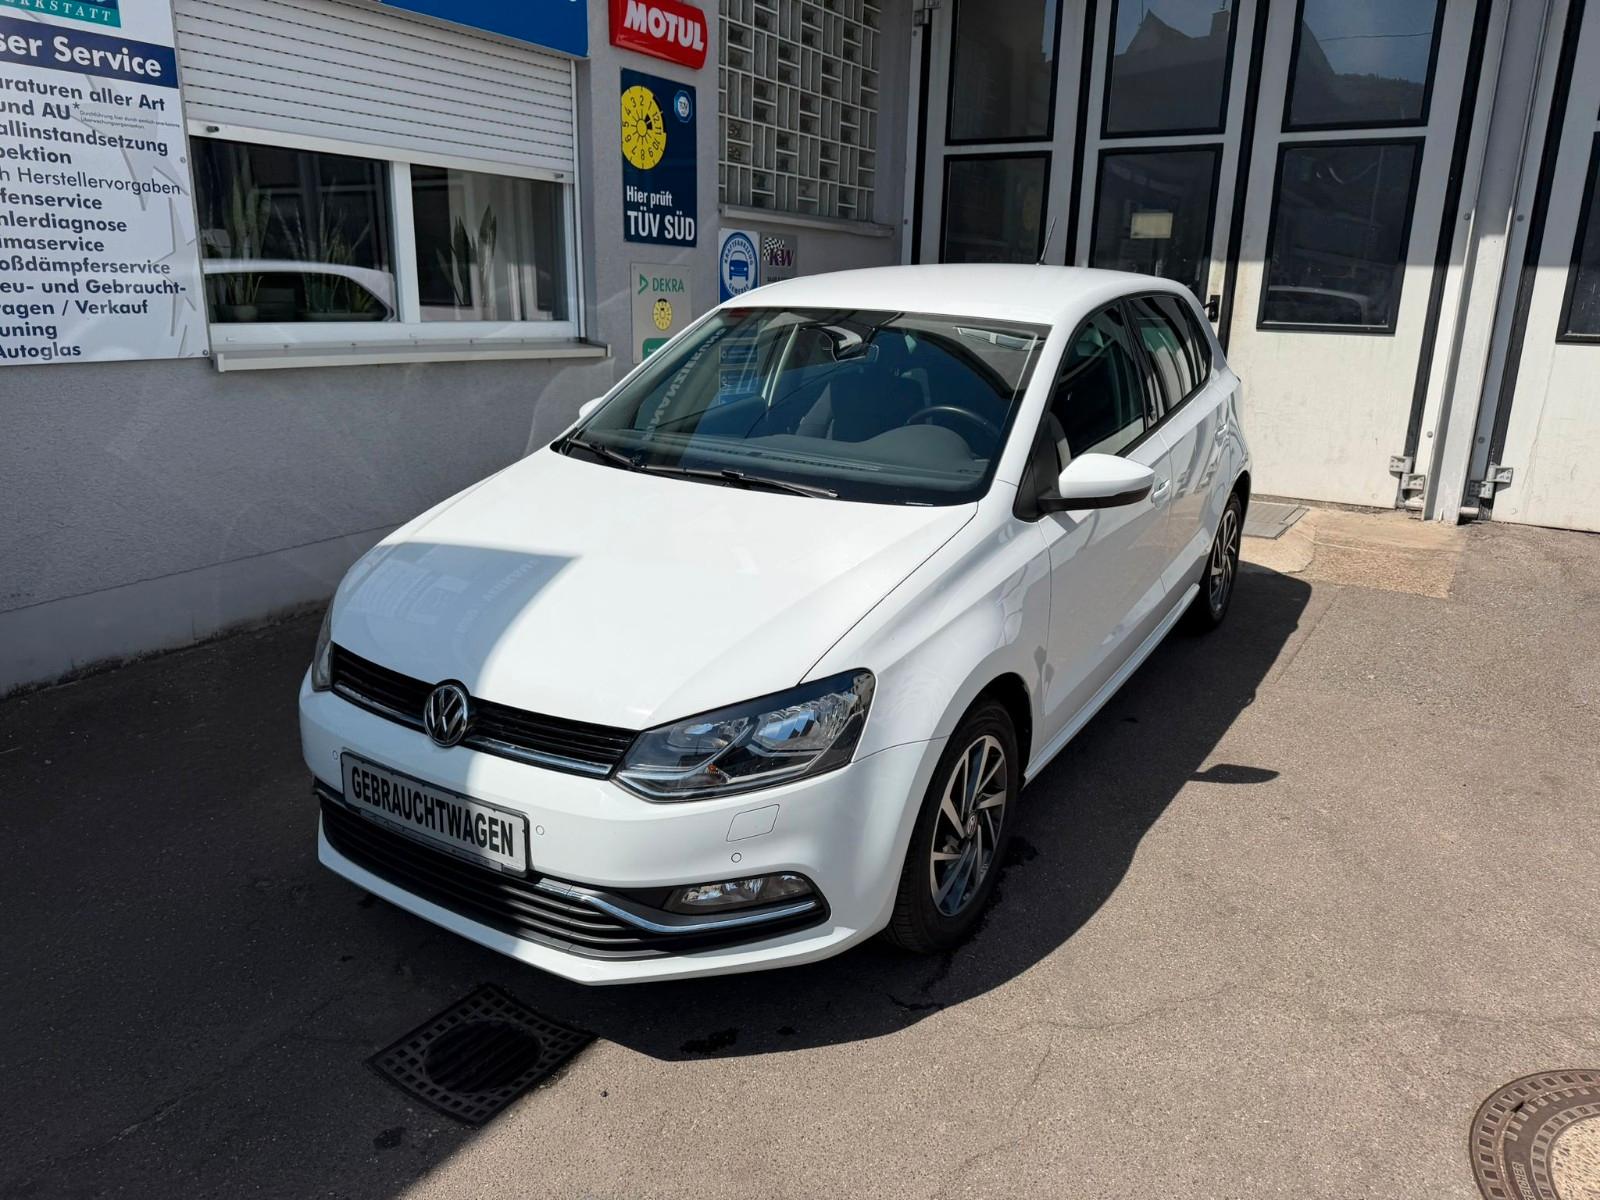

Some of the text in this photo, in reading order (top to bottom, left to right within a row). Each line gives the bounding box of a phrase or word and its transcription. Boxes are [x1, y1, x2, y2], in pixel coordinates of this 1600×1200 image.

[624, 0, 704, 52] MOTUL
[53, 36, 162, 77] Service
[0, 78, 165, 111] raturen aller Art
[18, 167, 180, 195] Herstellervorgaben
[0, 187, 102, 210] fenservice
[627, 185, 673, 209] Hier prüft
[627, 205, 695, 241] TÜV SÜD
[0, 236, 104, 252] maservice
[0, 255, 170, 276] oßdämpferservice
[0, 278, 186, 294] eu- und Gebraucht-
[652, 277, 685, 293] DEKRA
[0, 299, 148, 319] agen / Verkauf
[352, 766, 514, 857] GEBRAUCHTWAGEN
